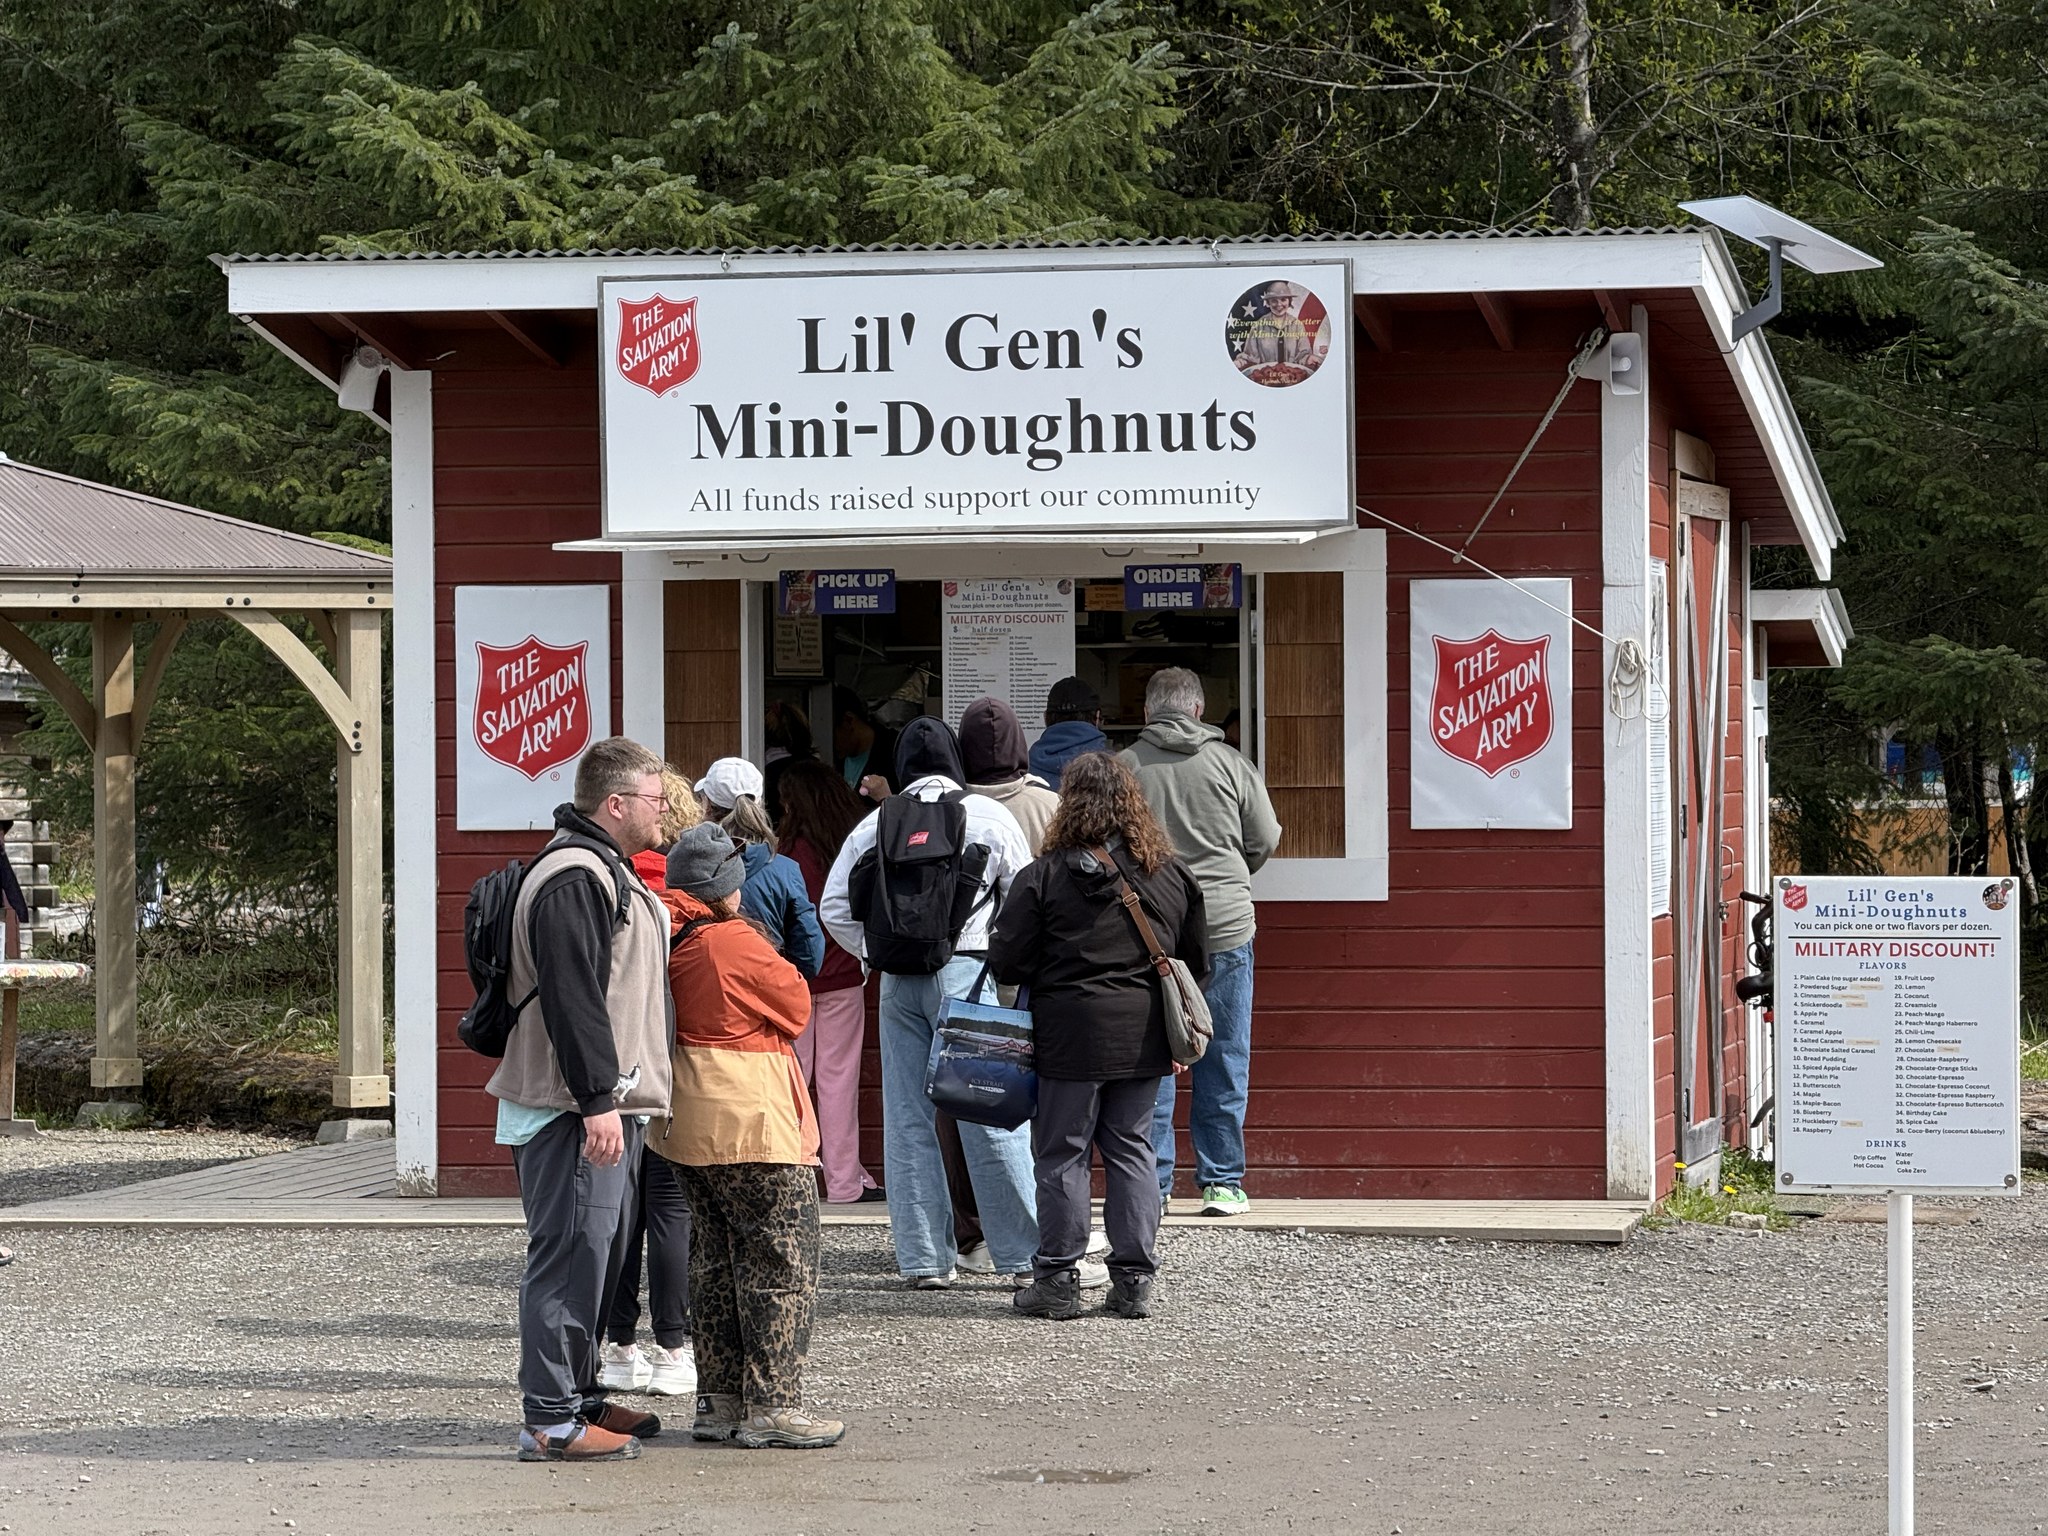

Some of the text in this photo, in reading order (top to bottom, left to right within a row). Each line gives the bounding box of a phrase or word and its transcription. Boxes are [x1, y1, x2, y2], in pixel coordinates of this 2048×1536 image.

[632, 303, 664, 336] THE
[622, 307, 692, 371] SALVATION
[797, 308, 1143, 373] Lil' Gen's
[1229, 330, 1250, 339] with
[647, 336, 690, 386] ARMY
[689, 398, 1256, 471] Mini-Doughnuts
[691, 481, 1261, 515] All funds raised support our community
[817, 574, 860, 588] PICK
[864, 573, 889, 587] UP
[1133, 568, 1200, 584] ORDER
[981, 583, 1030, 592] Lil' Gen's
[833, 595, 878, 609] HERE
[962, 593, 1048, 602] Mini-Doughnuts
[1143, 592, 1193, 607] HERE
[950, 614, 1065, 624] MILITARY DISCOUNT!
[953, 625, 958, 633] $
[496, 648, 541, 695] THE
[1454, 642, 1500, 690] THE
[481, 656, 579, 744] SALVATION
[1437, 650, 1541, 741] SALVATION
[517, 697, 576, 765] ARMY
[1475, 692, 1538, 761] ARMY
[1848, 889, 1934, 902] Lil' Gen's
[1815, 904, 1967, 921] Mini-Doughnuts
[1794, 922, 1812, 930] You
[1833, 922, 1853, 932] pick
[1887, 923, 1905, 931] two
[1907, 922, 1940, 931] flavors
[1942, 923, 1958, 932] per
[1960, 922, 1992, 931] dozen.
[1795, 942, 1995, 958] MILITARY DISCOUNT!
[1859, 962, 1907, 970] FLAVORS
[1830, 984, 1848, 992] Sugar
[1802, 1127, 1832, 1135] Raspberry
[1866, 1140, 1907, 1148] DRINKS
